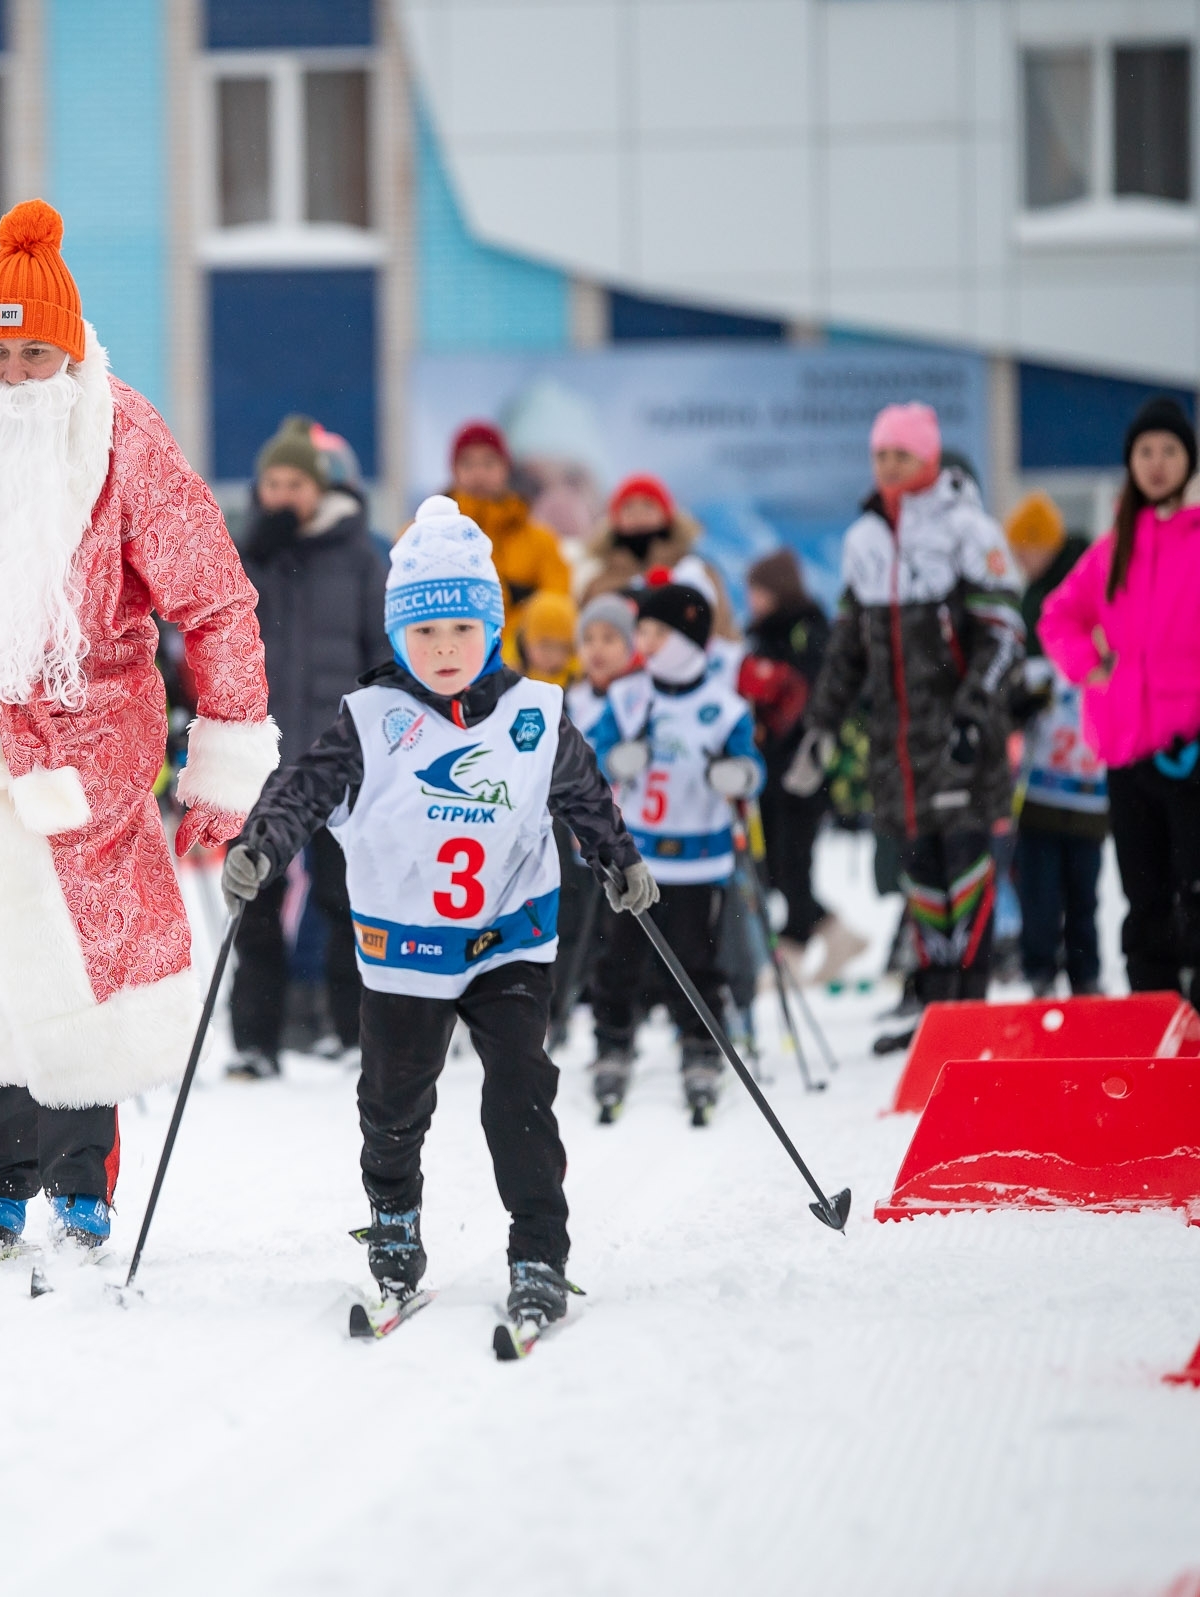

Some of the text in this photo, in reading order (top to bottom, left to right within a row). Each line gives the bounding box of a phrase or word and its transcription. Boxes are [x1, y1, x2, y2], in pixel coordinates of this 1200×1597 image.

[427, 804, 496, 824] СТРИЖ
[641, 771, 669, 827] 5
[433, 836, 486, 920] 3
[417, 943, 443, 956] ПСБ
